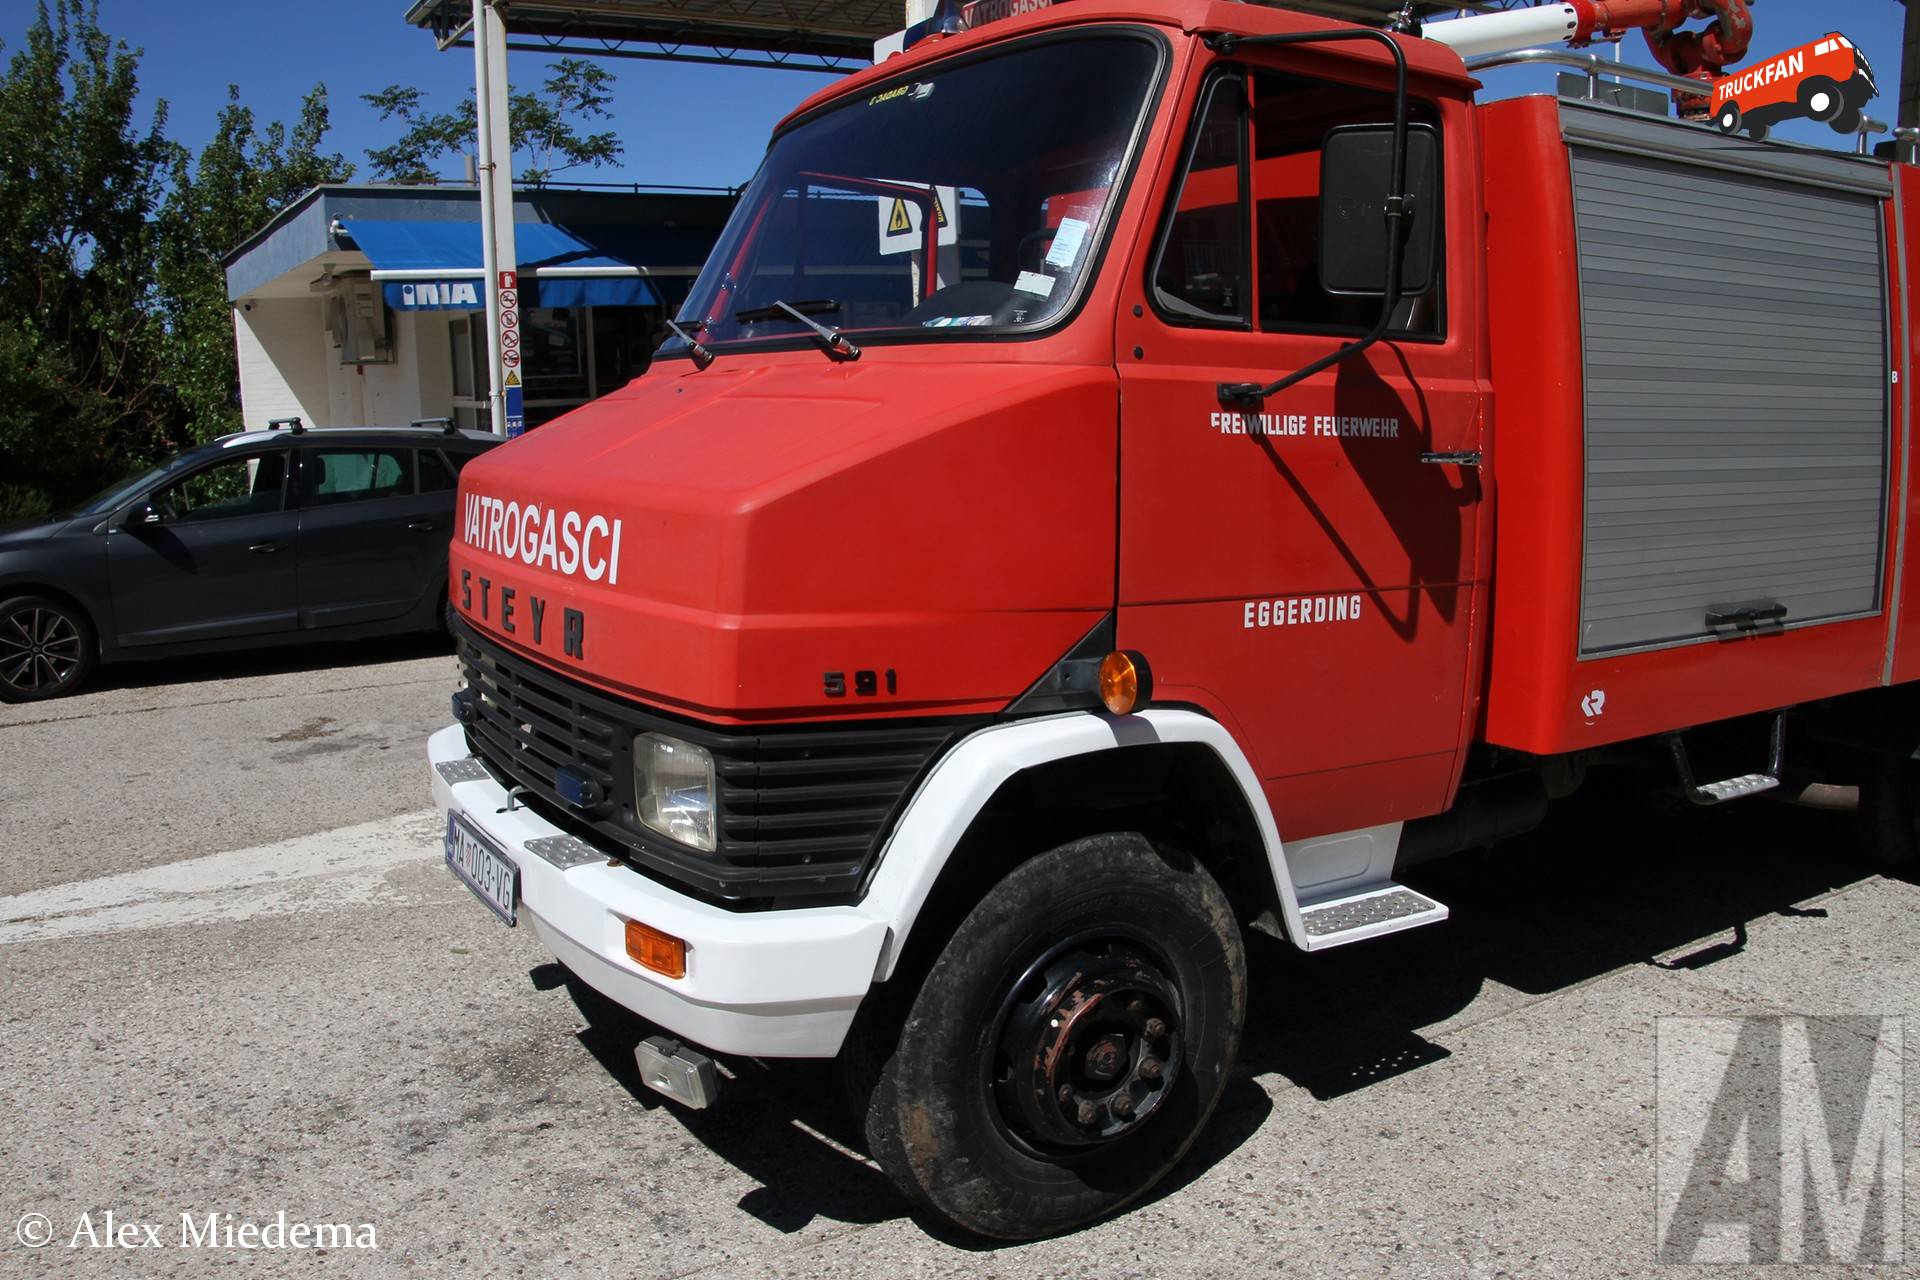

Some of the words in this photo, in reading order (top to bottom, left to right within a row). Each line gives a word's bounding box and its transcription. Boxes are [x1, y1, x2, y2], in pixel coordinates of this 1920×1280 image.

[964, 0, 1054, 29] VATROGAS
[1891, 370, 1898, 384] B
[1210, 412, 1307, 436] FREIWILLIGE
[1313, 415, 1400, 438] FEUERWEHR
[464, 492, 622, 585] VATROGASCI
[461, 569, 585, 660] STEYR
[1244, 595, 1361, 628] EGGERDING
[823, 668, 897, 698] 591
